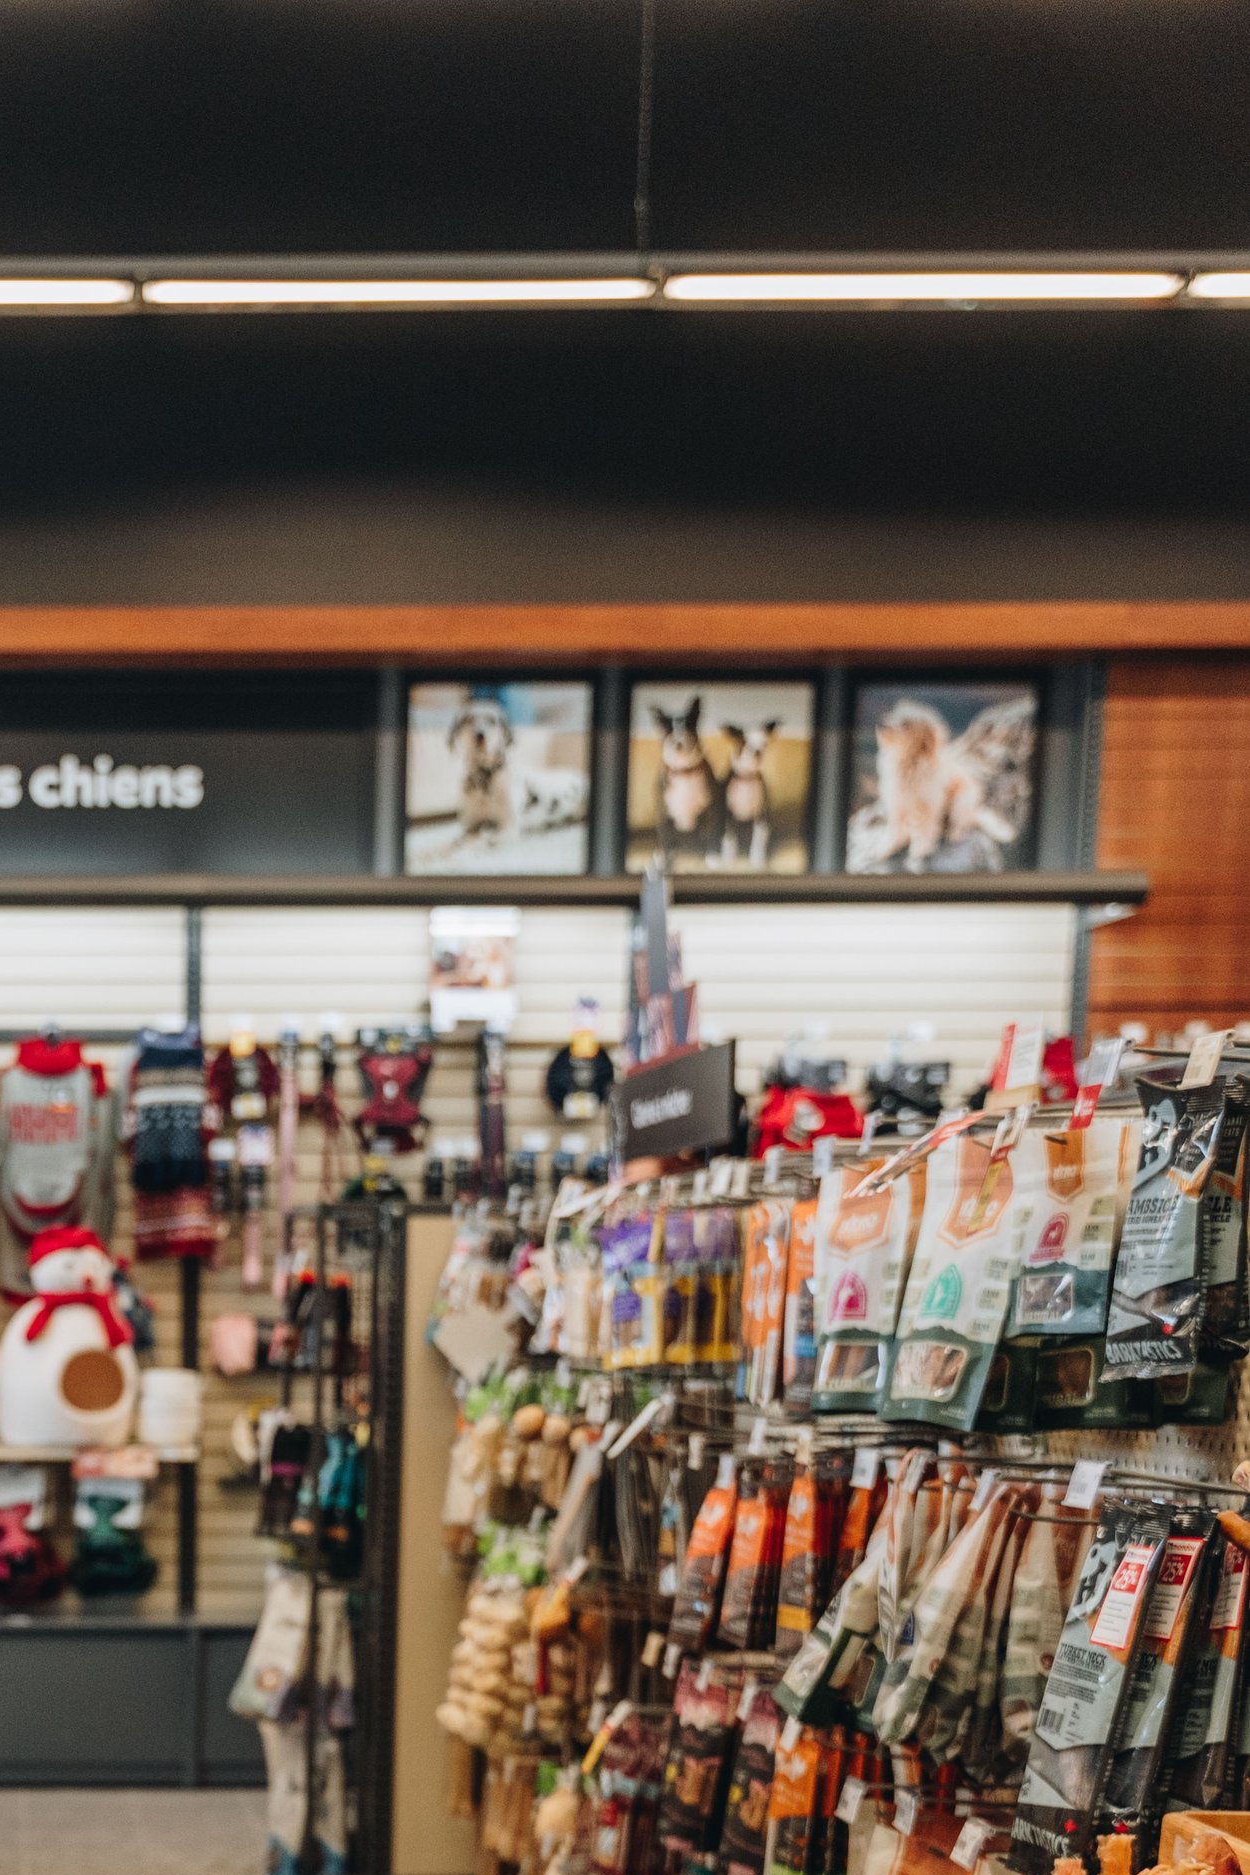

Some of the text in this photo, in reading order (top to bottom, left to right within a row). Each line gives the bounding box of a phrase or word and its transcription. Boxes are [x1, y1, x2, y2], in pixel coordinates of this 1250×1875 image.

[29, 753, 205, 808] chiens
[1106, 1340, 1183, 1366] BARKTASTICS
[1084, 1648, 1108, 1666] NECK
